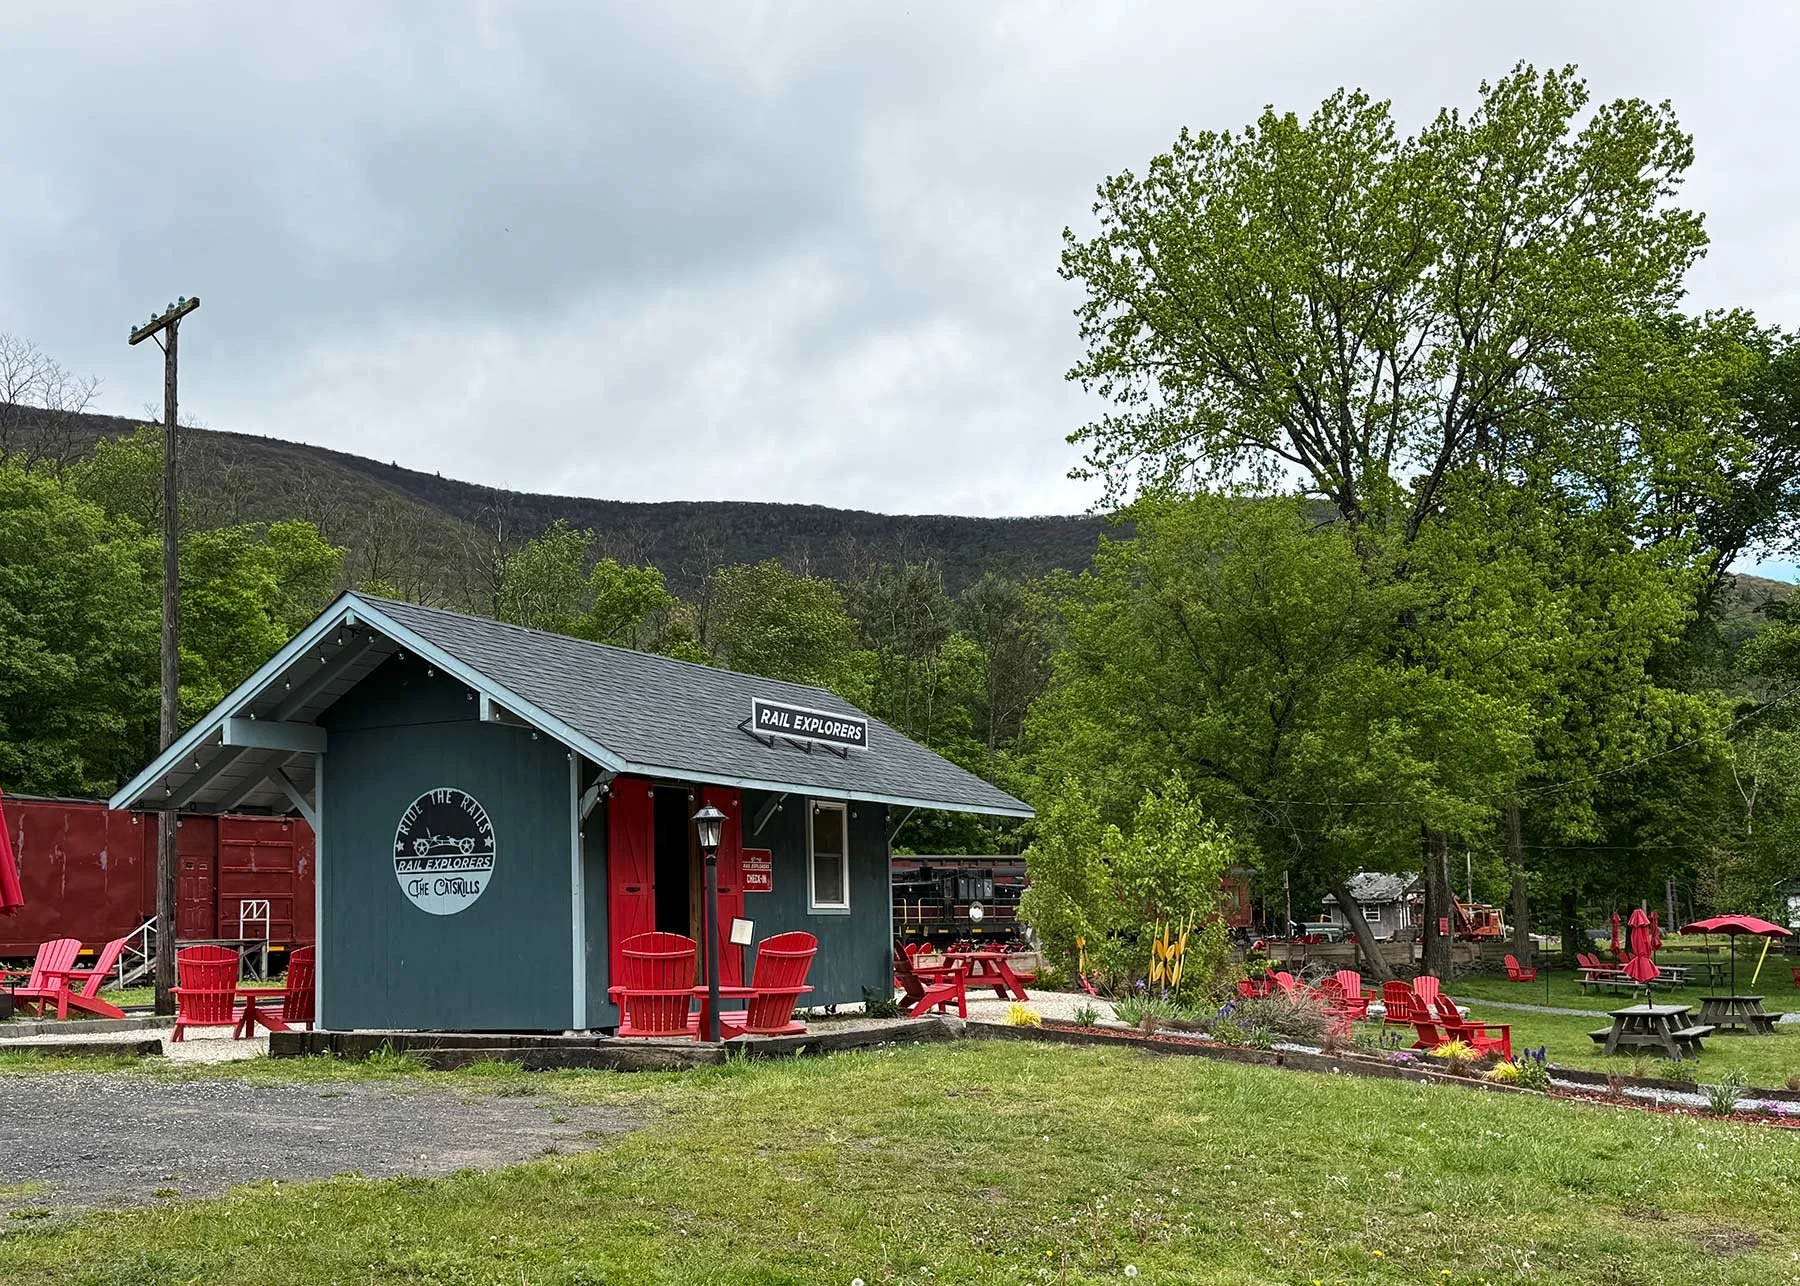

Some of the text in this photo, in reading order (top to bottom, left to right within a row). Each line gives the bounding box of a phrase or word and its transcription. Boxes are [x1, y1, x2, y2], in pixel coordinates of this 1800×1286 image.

[760, 709, 862, 740] RAIL EXPLORERS
[399, 790, 491, 836] RIDE THE RAILS
[398, 857, 491, 872] RAIL EXPLORERS
[746, 874, 767, 884] CHECK-IN
